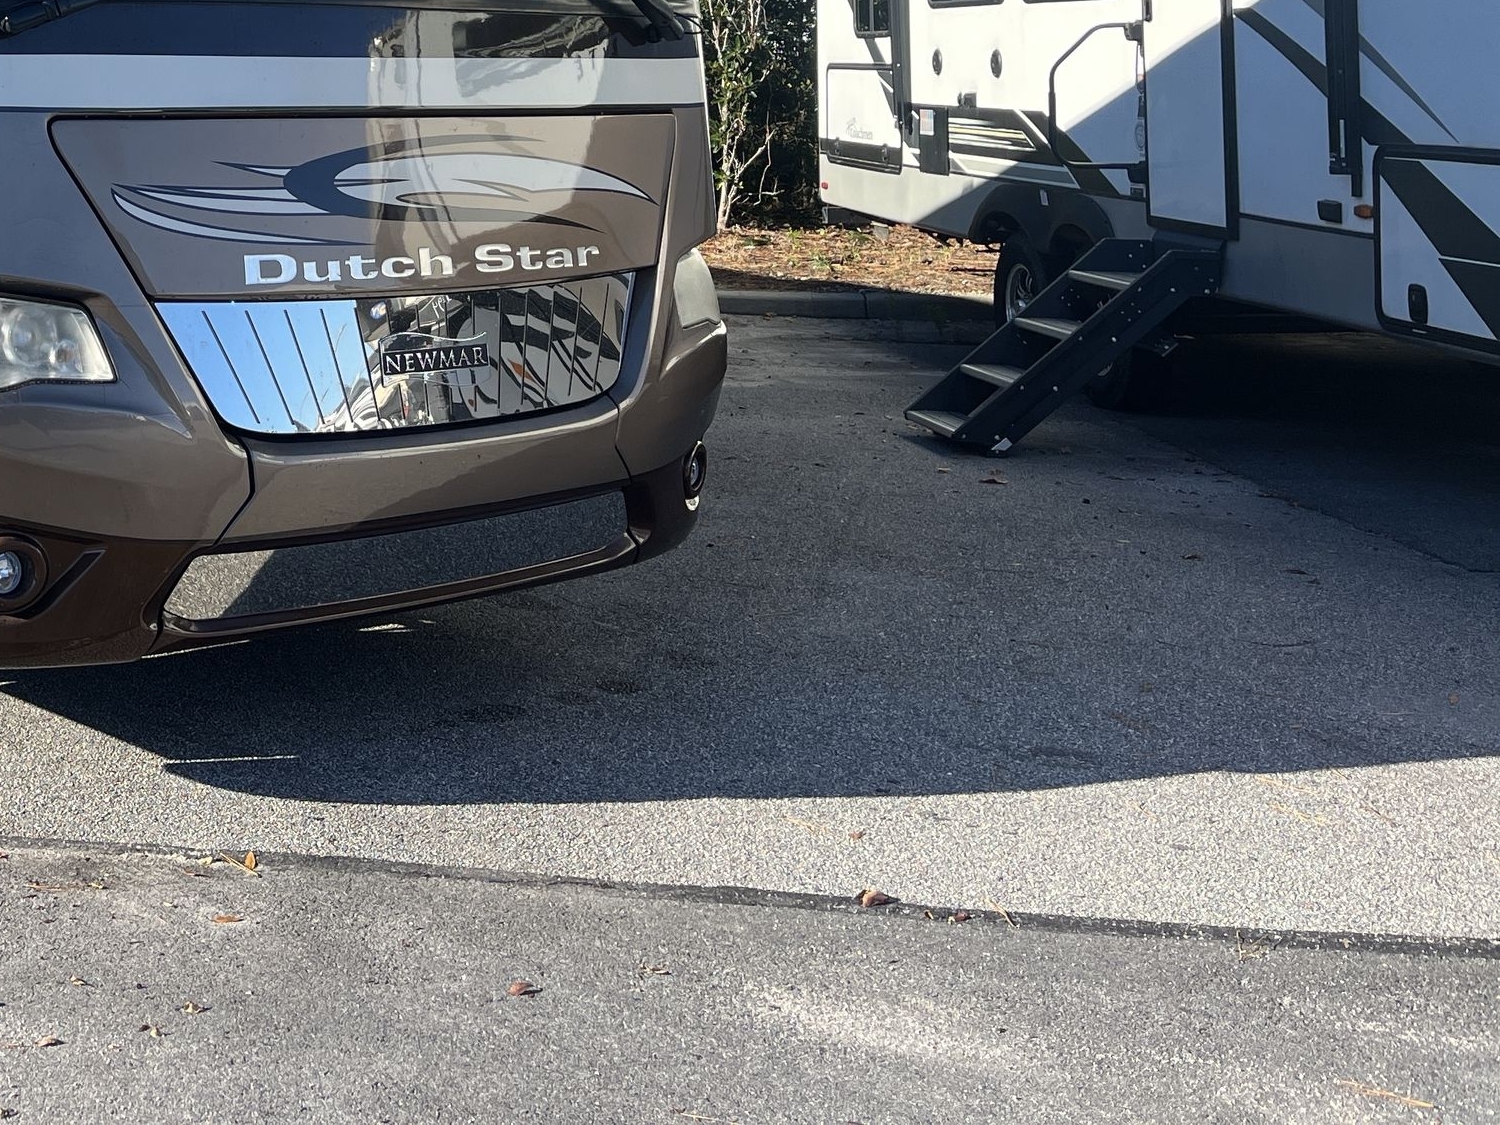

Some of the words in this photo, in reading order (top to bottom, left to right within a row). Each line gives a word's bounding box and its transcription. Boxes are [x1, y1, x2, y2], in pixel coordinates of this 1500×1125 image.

[243, 246, 454, 286] Dutch
[474, 242, 601, 274] Star
[384, 346, 487, 375] NEWMAR
